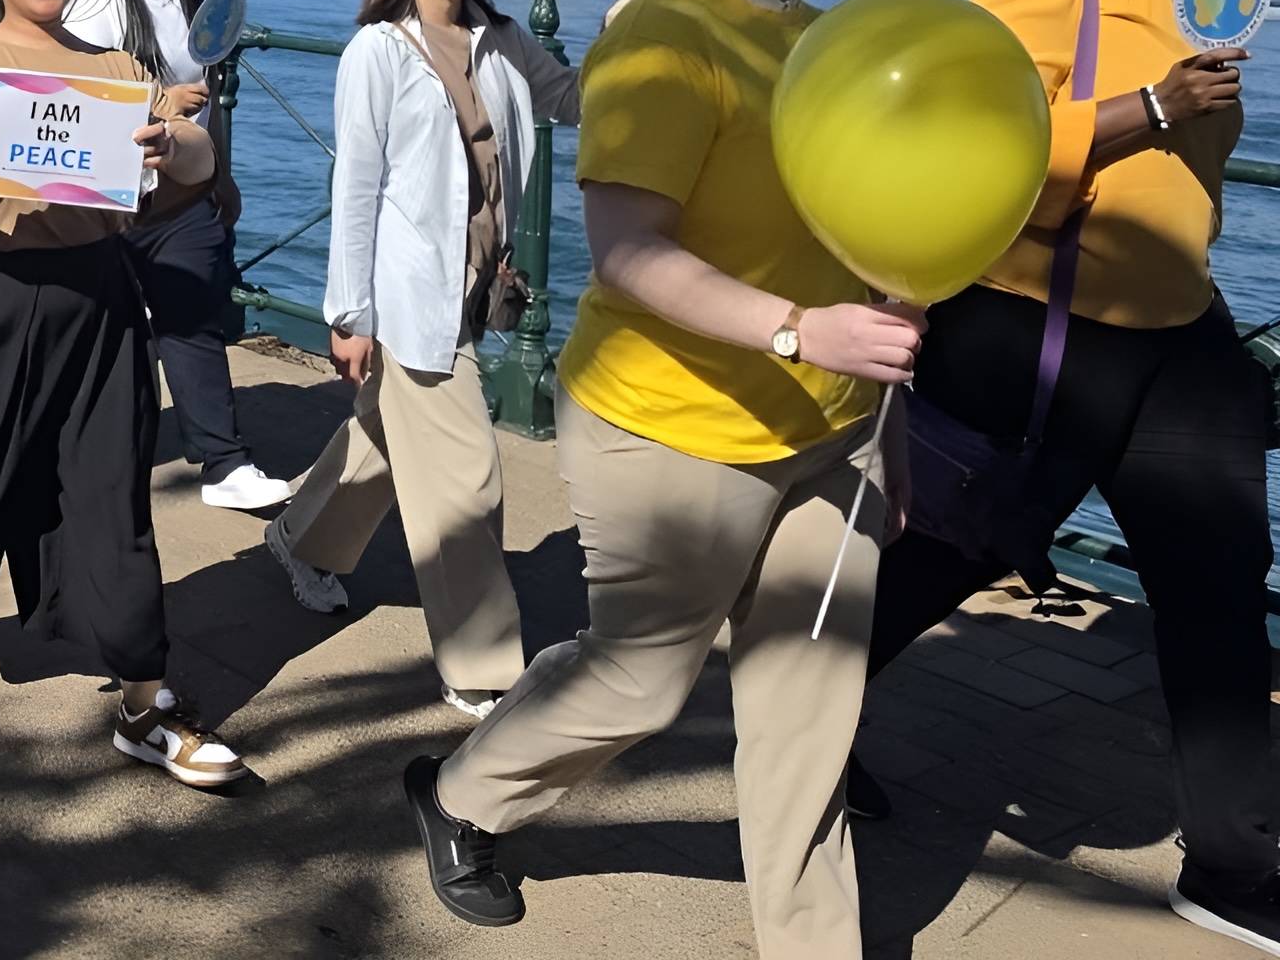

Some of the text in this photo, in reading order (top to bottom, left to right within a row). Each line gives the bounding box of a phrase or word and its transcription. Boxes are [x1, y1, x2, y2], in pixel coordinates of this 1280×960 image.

[30, 101, 81, 124] I AM
[37, 124, 70, 143] the
[9, 143, 92, 170] PEACE
